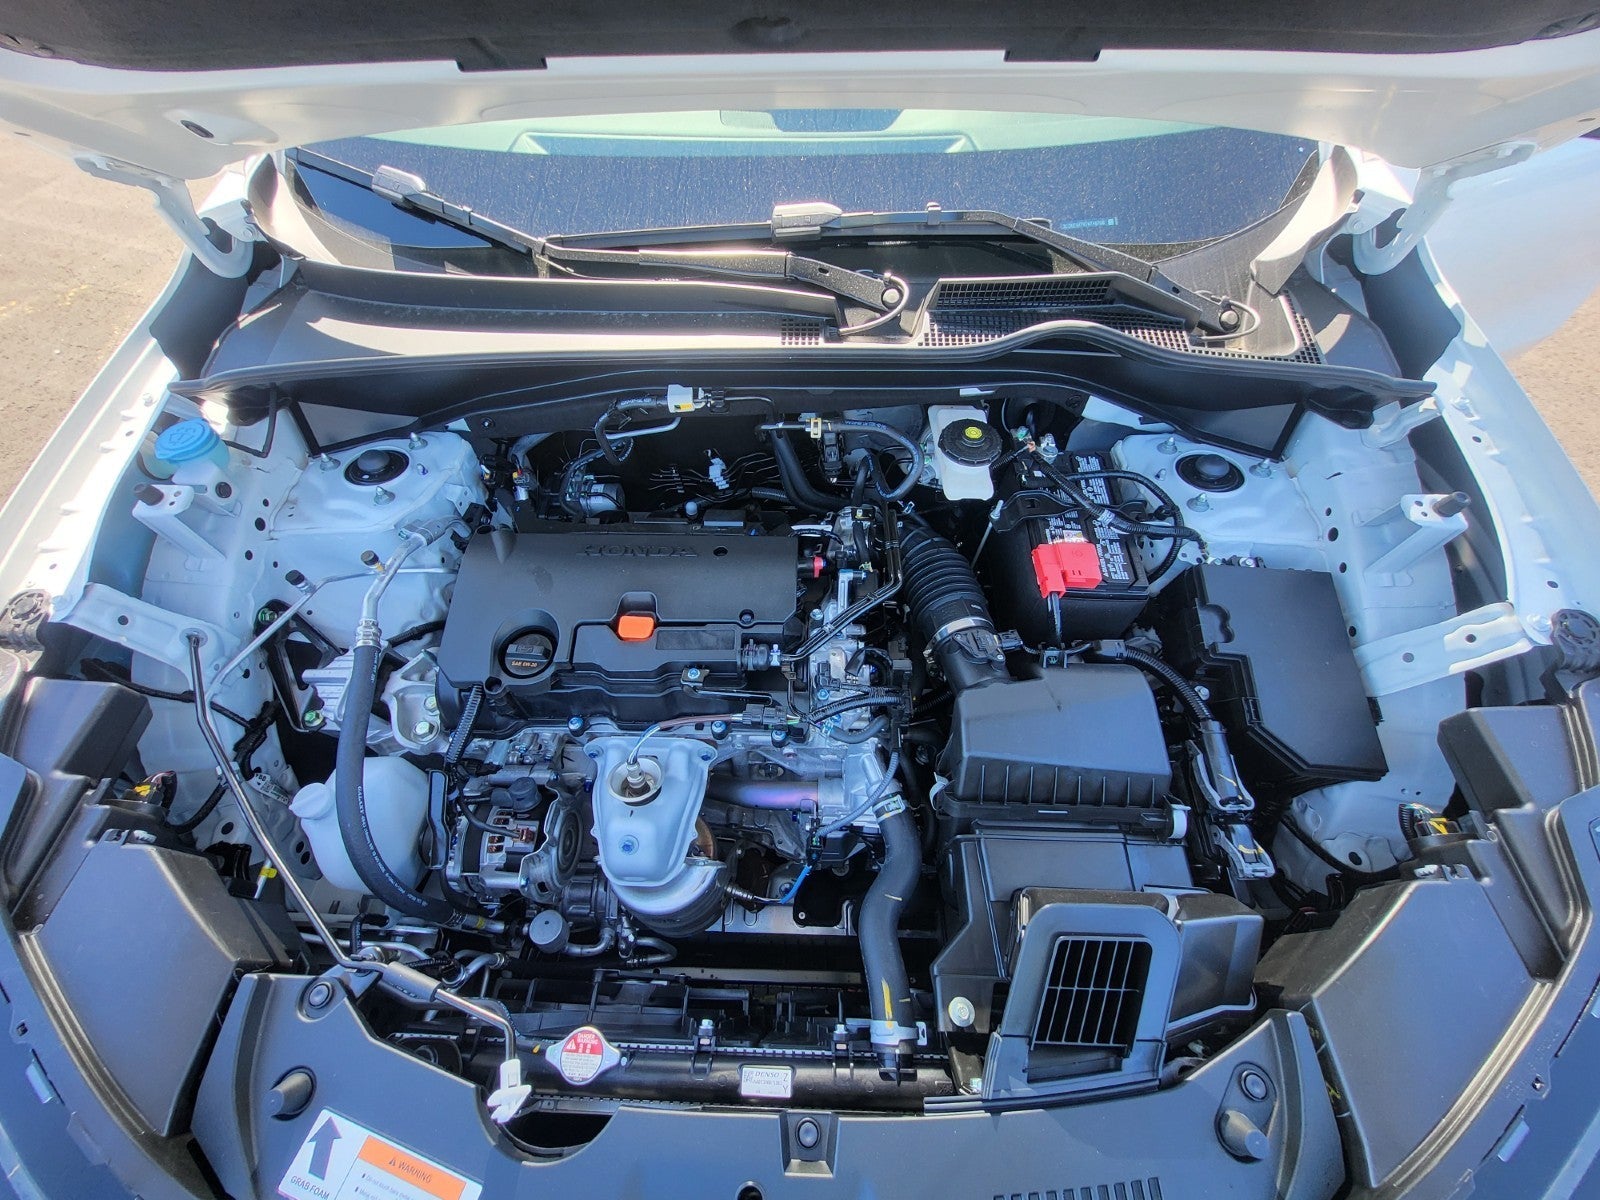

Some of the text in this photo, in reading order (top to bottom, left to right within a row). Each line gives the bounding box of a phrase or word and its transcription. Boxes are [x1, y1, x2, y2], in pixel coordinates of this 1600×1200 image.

[583, 544, 698, 557] HONDA
[398, 1160, 433, 1183] WARNING
[290, 1175, 330, 1200] GRAB FOAM
